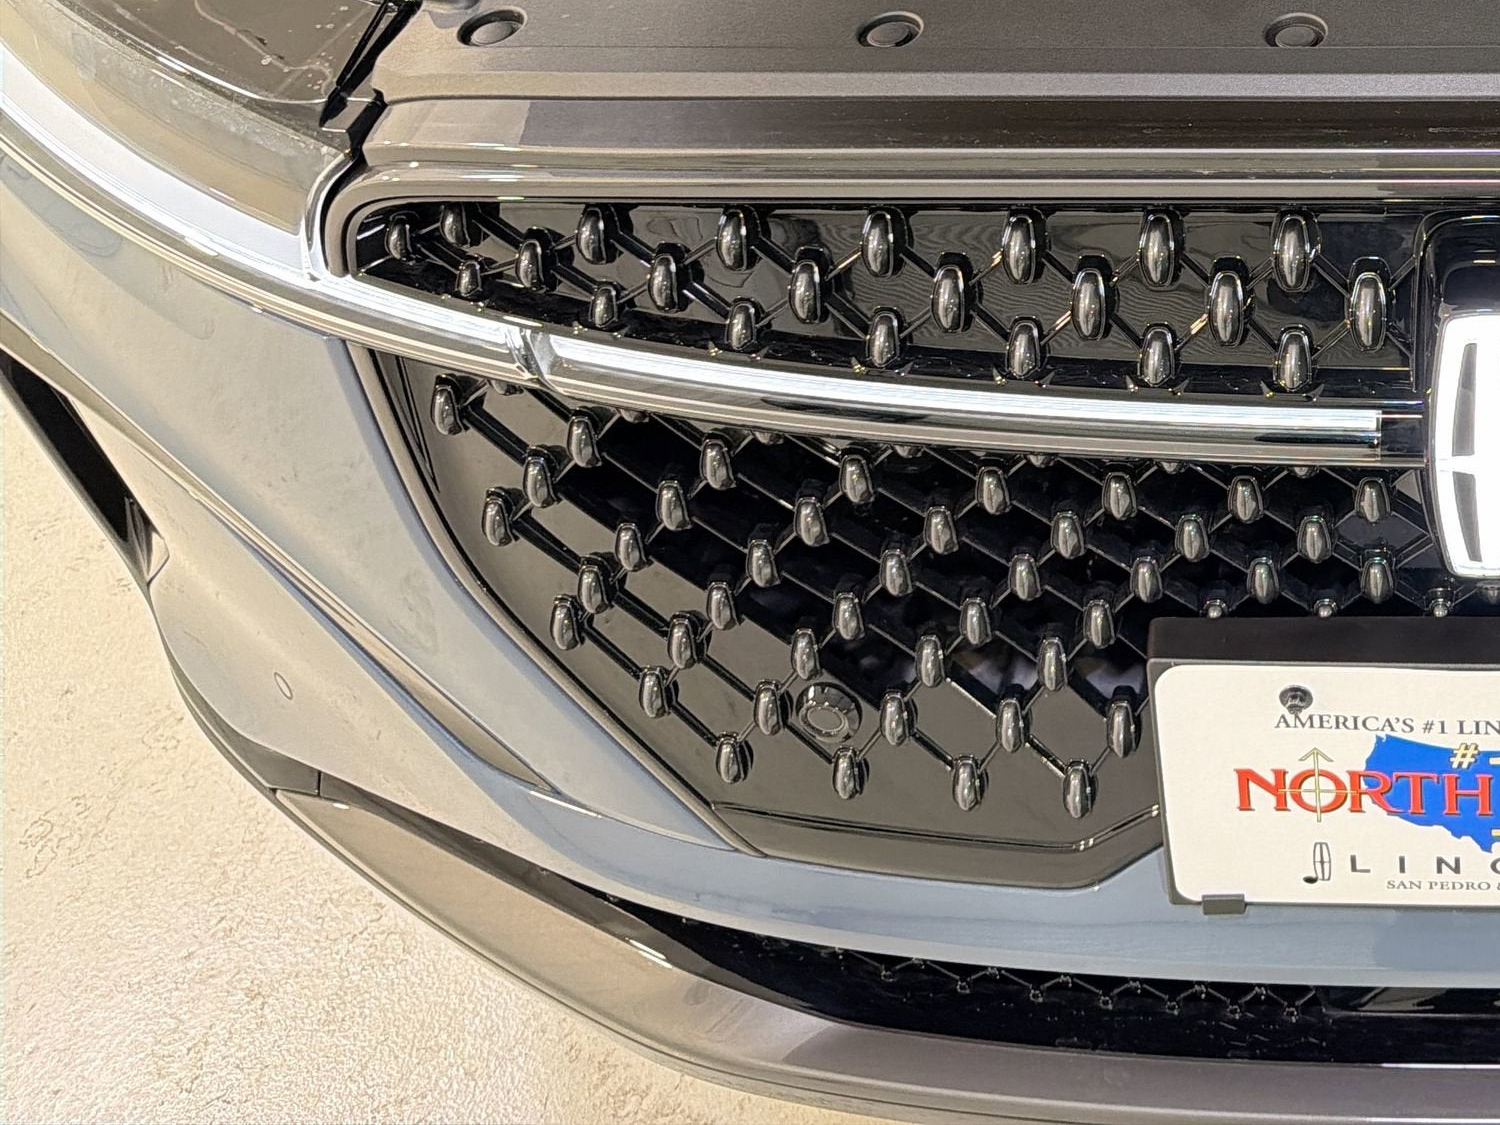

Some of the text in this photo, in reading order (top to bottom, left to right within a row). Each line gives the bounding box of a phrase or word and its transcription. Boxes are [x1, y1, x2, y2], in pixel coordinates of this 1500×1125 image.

[1274, 713, 1415, 734] AMERICA'S
[1422, 719, 1449, 734] #1
[1233, 768, 1495, 817] NORTH
[1386, 879, 1424, 891] SAN
[1429, 879, 1492, 892] PEDRO
